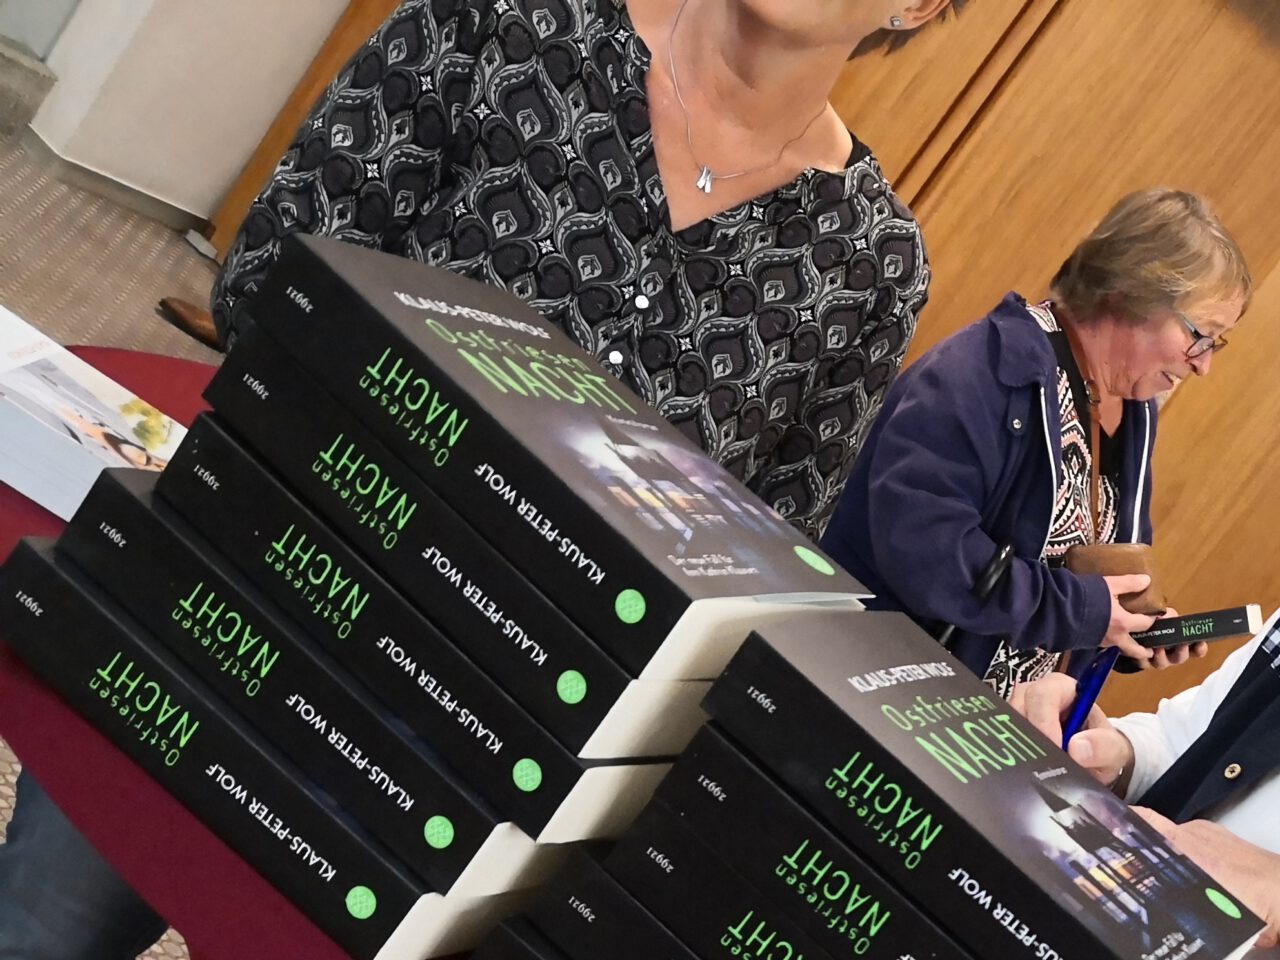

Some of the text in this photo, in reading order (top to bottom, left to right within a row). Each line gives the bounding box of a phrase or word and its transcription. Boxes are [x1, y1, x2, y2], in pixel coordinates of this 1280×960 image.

[359, 377, 449, 467] Ostfriesen
[366, 348, 469, 447] NACHT
[457, 348, 638, 414] NACHT
[312, 459, 397, 549] Ostfriesen
[319, 434, 417, 530] NACHT
[474, 463, 606, 585] KLAUS-PETER WOLF
[265, 552, 351, 639] Ostfriesen
[272, 526, 370, 620] NACHT
[421, 546, 548, 666] KLAUS-PETER WOLF
[172, 608, 260, 697] Ostfriesen
[179, 582, 280, 678] NACHT
[1181, 622, 1214, 638] NACHT
[89, 677, 180, 766] Ostfriesen
[96, 652, 199, 748] NACHT
[376, 635, 504, 755] KLAUS-PETER WOLF
[847, 663, 930, 694] KLAUS-PETER
[880, 695, 998, 732] Ostfriesen
[285, 693, 415, 812] KLAUS-PETER WOLF
[914, 713, 1048, 784] NACHT
[205, 763, 337, 882] KLAUS-PETER WOLF
[825, 776, 921, 869] Ostfriesen
[833, 752, 943, 851] NACHT
[775, 866, 870, 954] Ostfriesen
[783, 839, 891, 937] NACHT
[947, 867, 993, 910] WOLF
